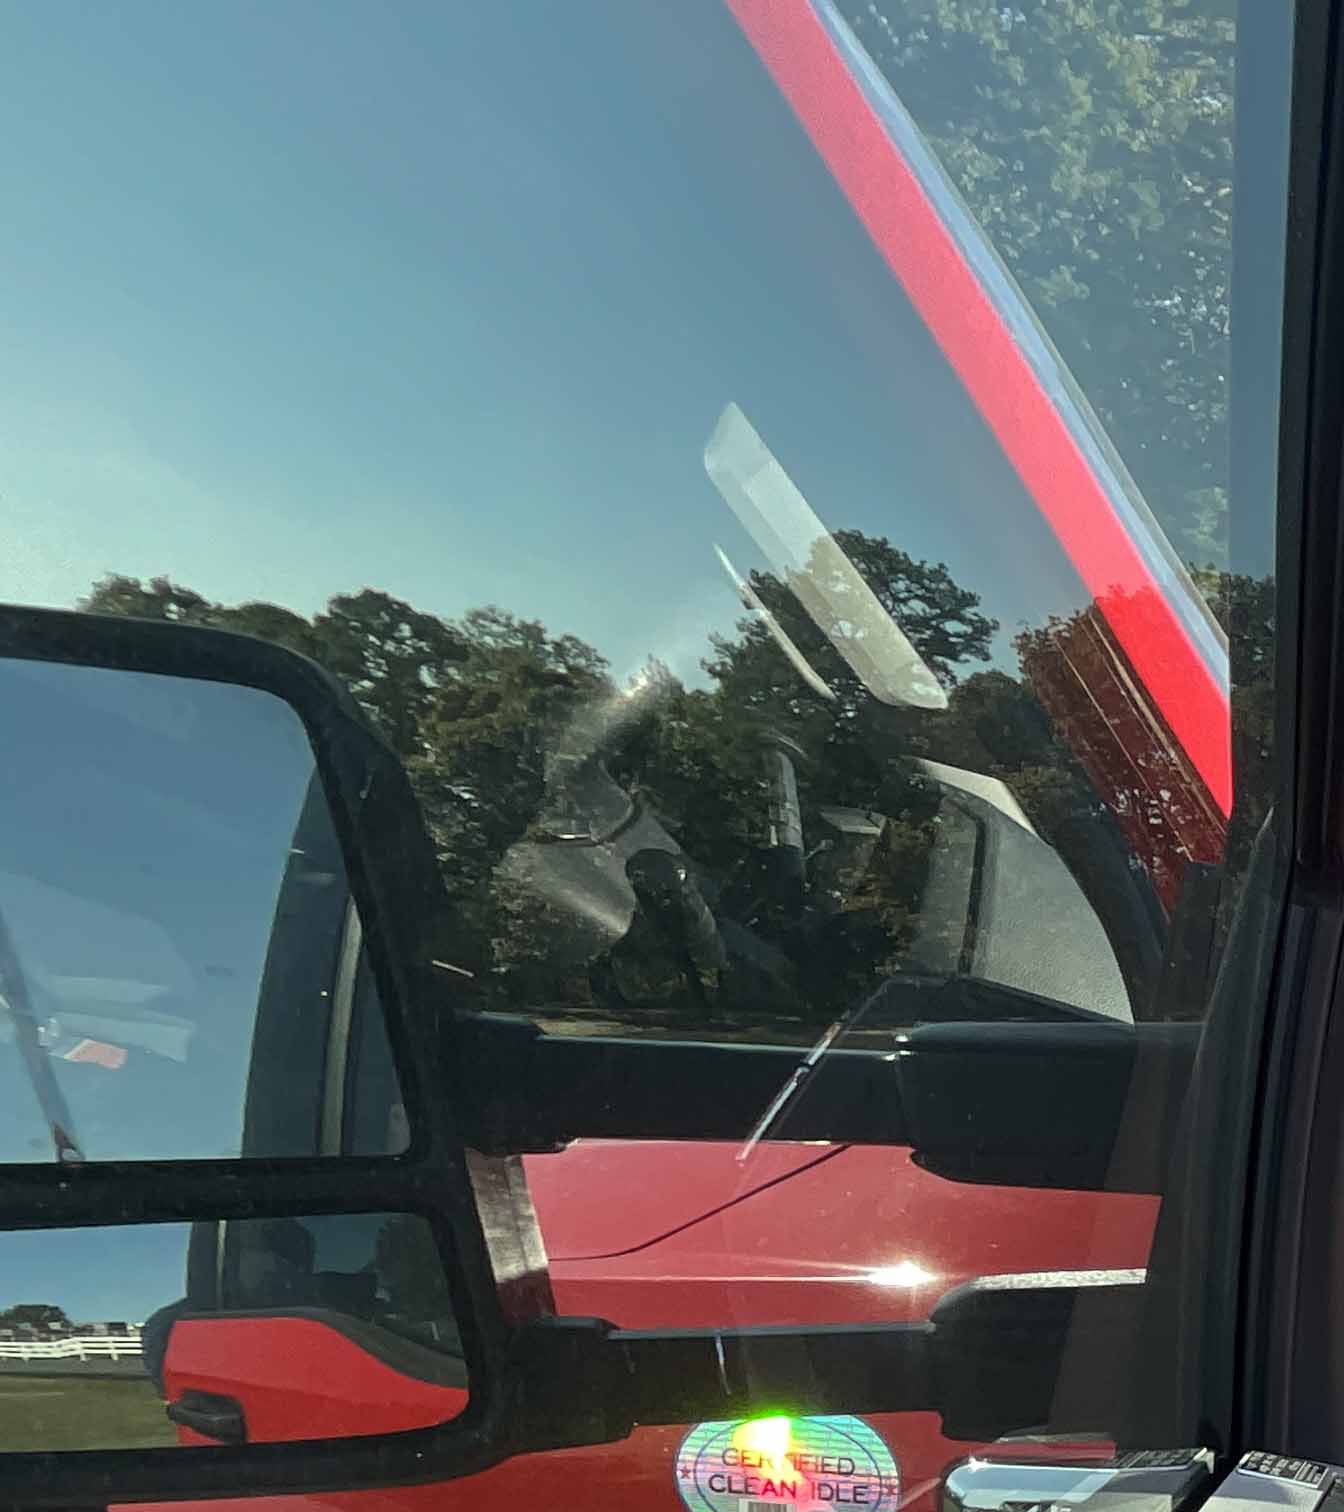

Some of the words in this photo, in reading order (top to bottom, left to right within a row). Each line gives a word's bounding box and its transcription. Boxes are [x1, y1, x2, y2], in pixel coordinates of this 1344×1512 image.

[722, 1447, 856, 1475] CERIFIED
[708, 1474, 797, 1499] CLEAN
[811, 1481, 869, 1504] IDLE
